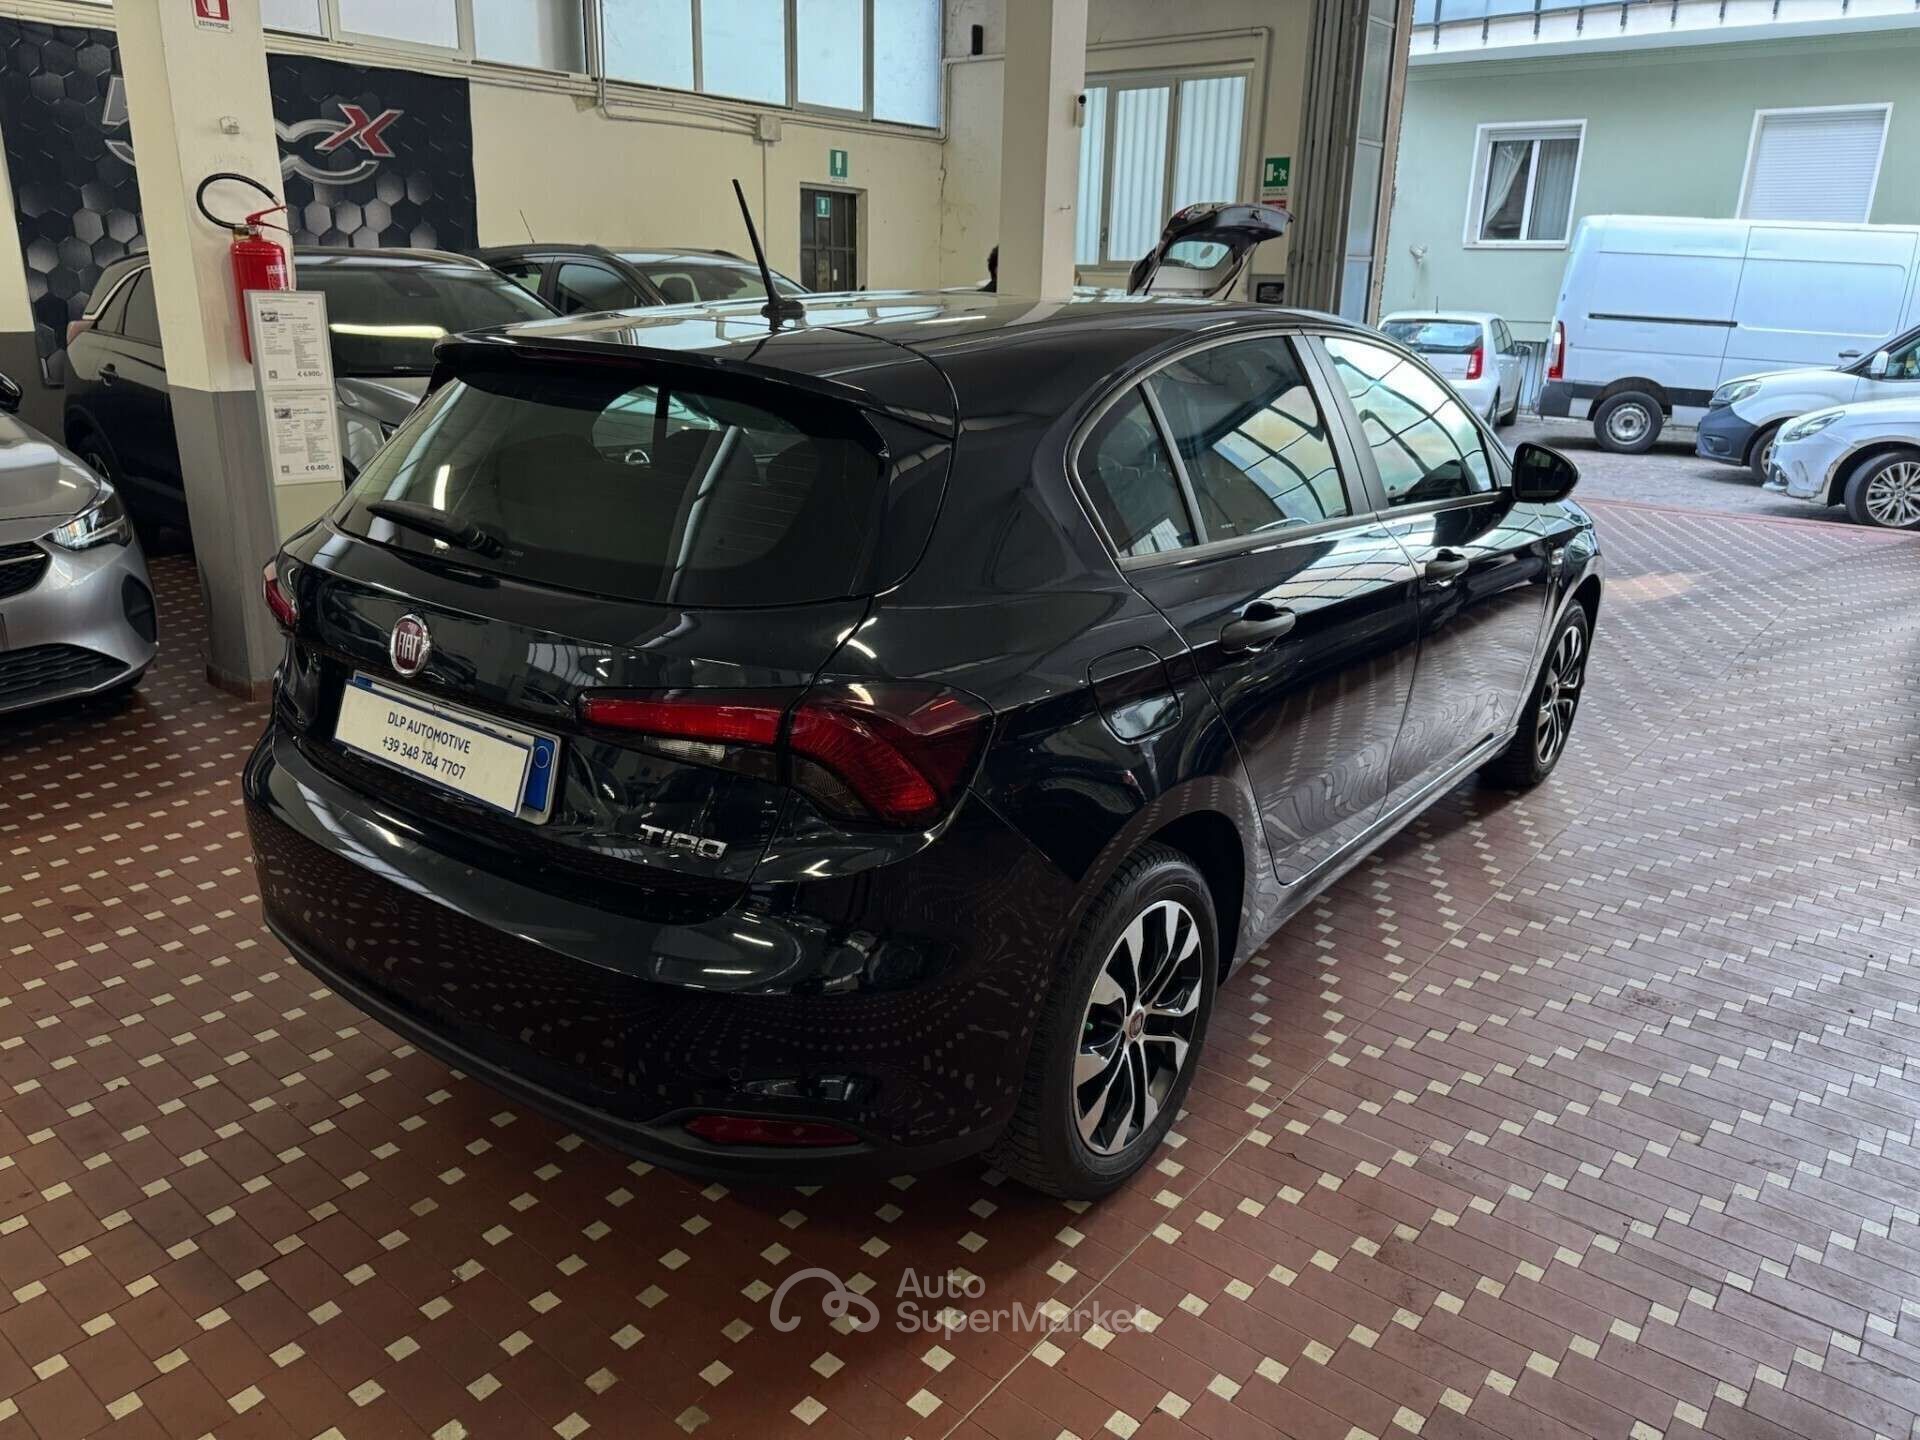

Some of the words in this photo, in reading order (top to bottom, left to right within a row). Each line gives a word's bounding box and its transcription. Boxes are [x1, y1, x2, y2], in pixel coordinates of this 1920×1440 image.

[397, 631, 421, 662] FIAT
[387, 711, 407, 729] DLP
[407, 719, 471, 754] AUTOMOTIVE
[382, 737, 400, 752] +39
[400, 742, 418, 760] 348
[421, 750, 438, 769] 784
[441, 758, 466, 780] 7707
[640, 823, 728, 860] TIPO
